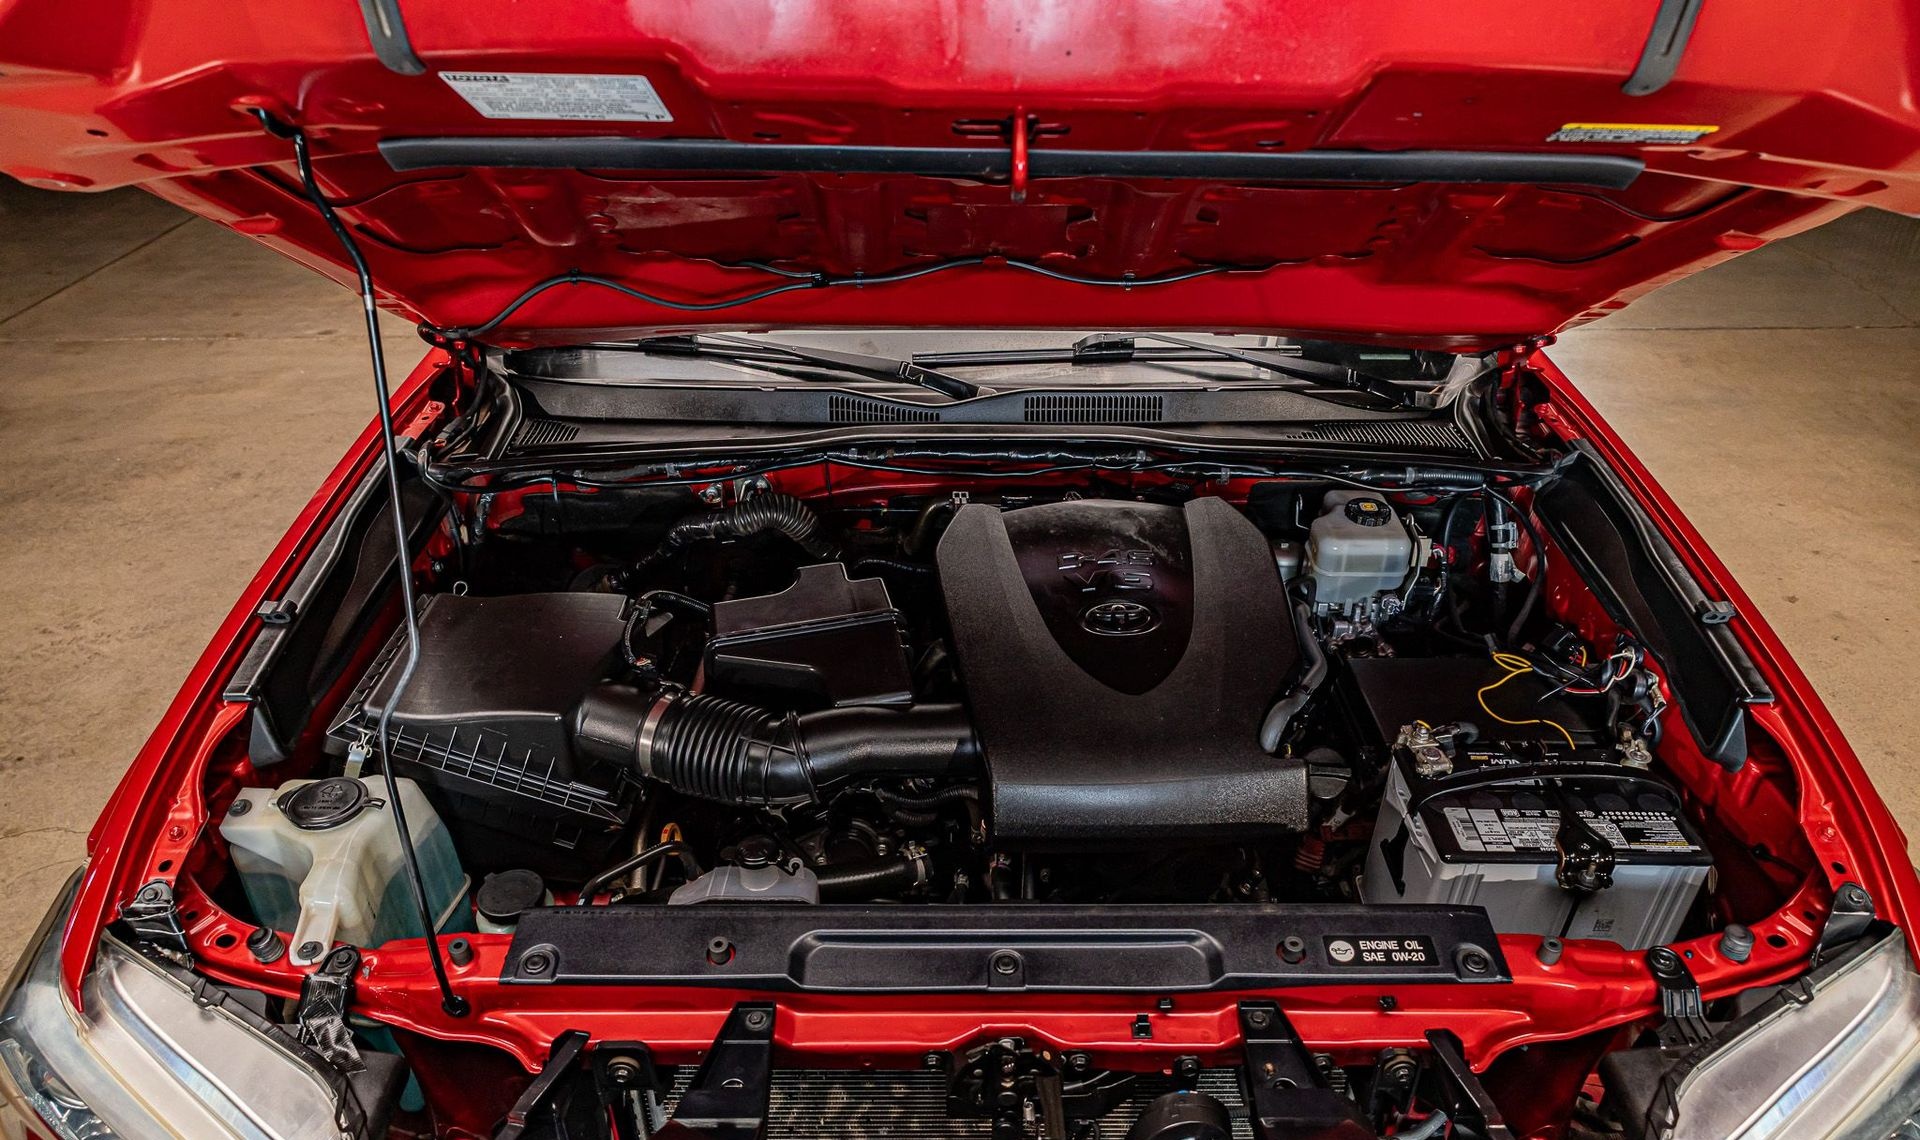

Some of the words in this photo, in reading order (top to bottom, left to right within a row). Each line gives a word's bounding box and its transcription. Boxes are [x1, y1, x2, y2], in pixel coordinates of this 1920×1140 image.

[1359, 940, 1399, 950] ENGINE
[1404, 940, 1423, 950] OIL
[1362, 952, 1386, 962] SAE
[1391, 952, 1426, 962] 0W-20
